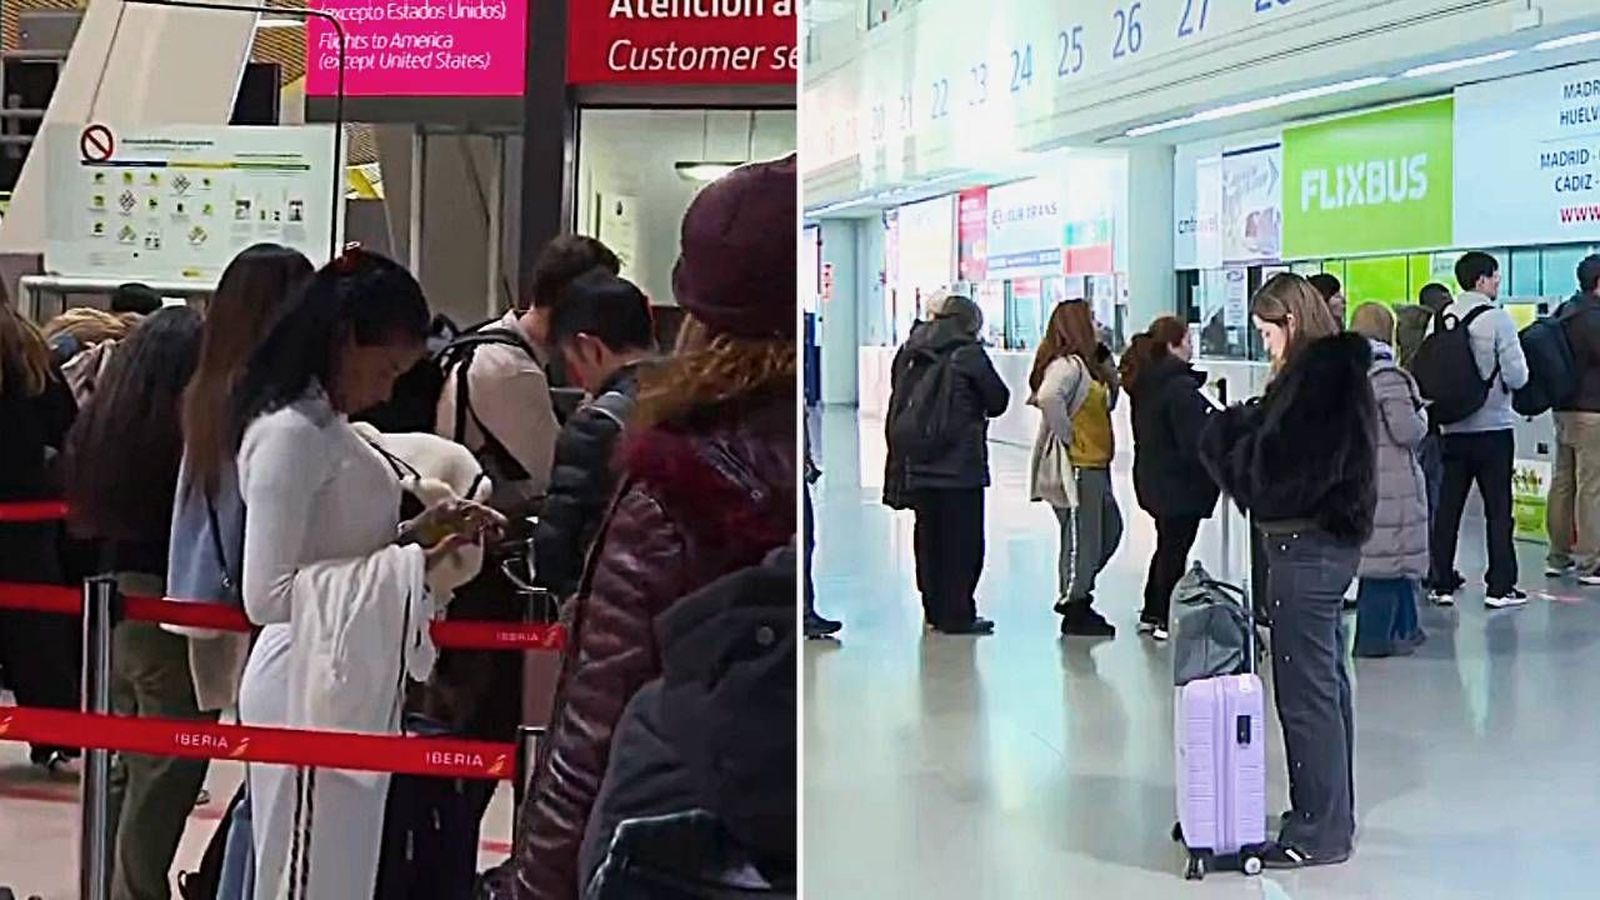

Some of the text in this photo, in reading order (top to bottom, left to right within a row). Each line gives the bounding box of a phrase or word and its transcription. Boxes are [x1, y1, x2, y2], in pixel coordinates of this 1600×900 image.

[387, 3, 445, 20] Estados
[448, 2, 507, 21] Unidos)
[371, 33, 388, 50] to
[389, 32, 454, 50] America
[380, 53, 431, 70] United
[435, 52, 491, 70] States)
[608, 39, 767, 72] Customer
[930, 78, 949, 120] 22
[1008, 44, 1033, 92] 24
[1057, 26, 1083, 77] 25
[1112, 2, 1142, 59] 26
[1540, 149, 1590, 170] MADRID
[1300, 152, 1429, 214] FLIXBUS
[495, 630, 539, 642] IBERIA
[174, 733, 229, 750] IBERIA
[425, 751, 484, 767] IBERIA
